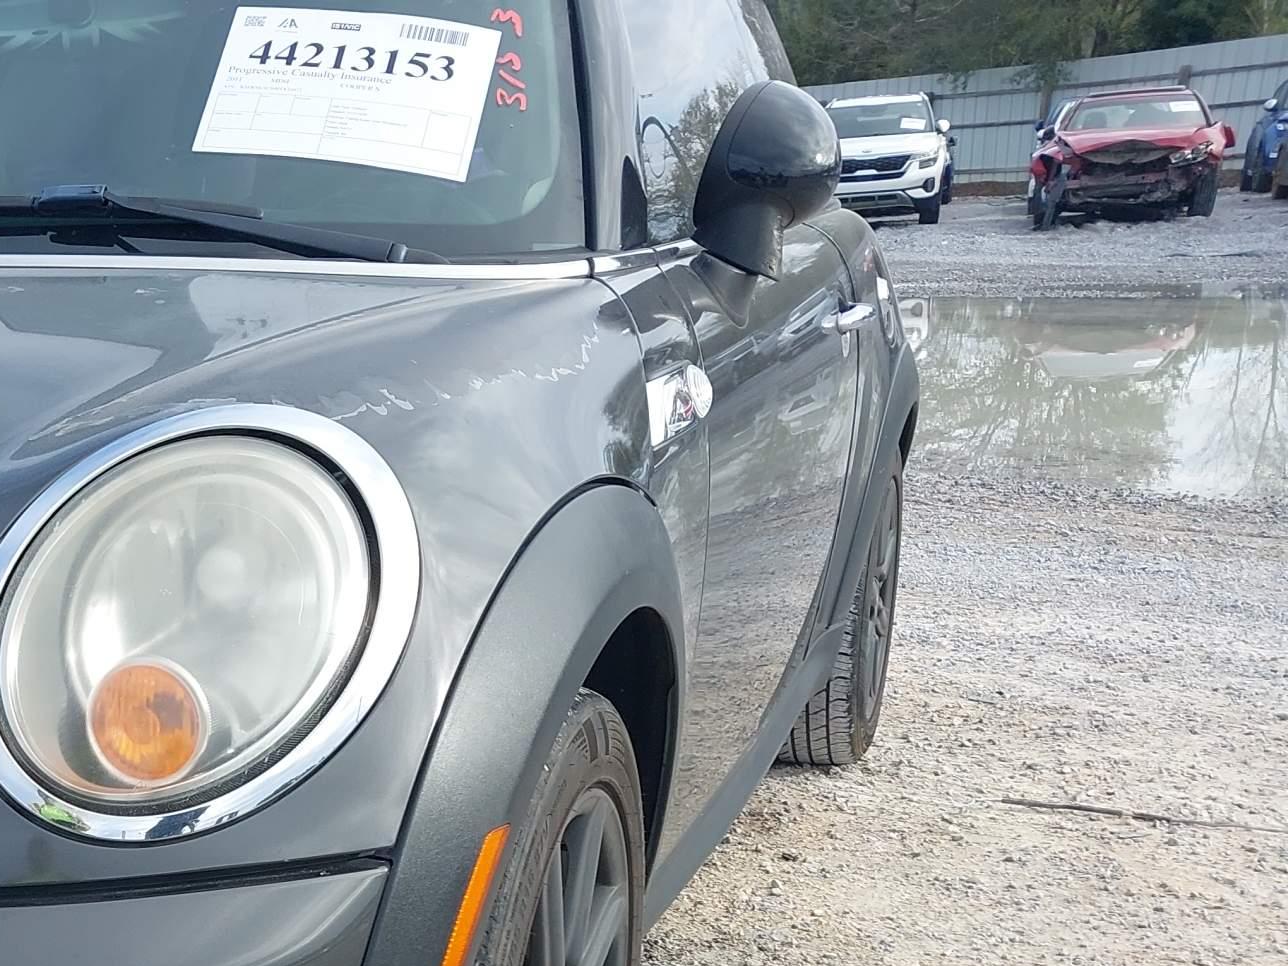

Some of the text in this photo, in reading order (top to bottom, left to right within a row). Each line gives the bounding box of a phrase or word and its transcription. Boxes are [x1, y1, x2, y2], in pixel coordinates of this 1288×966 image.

[228, 65, 393, 85] Progressive Casualty Insurance
[248, 40, 456, 82] 44213153
